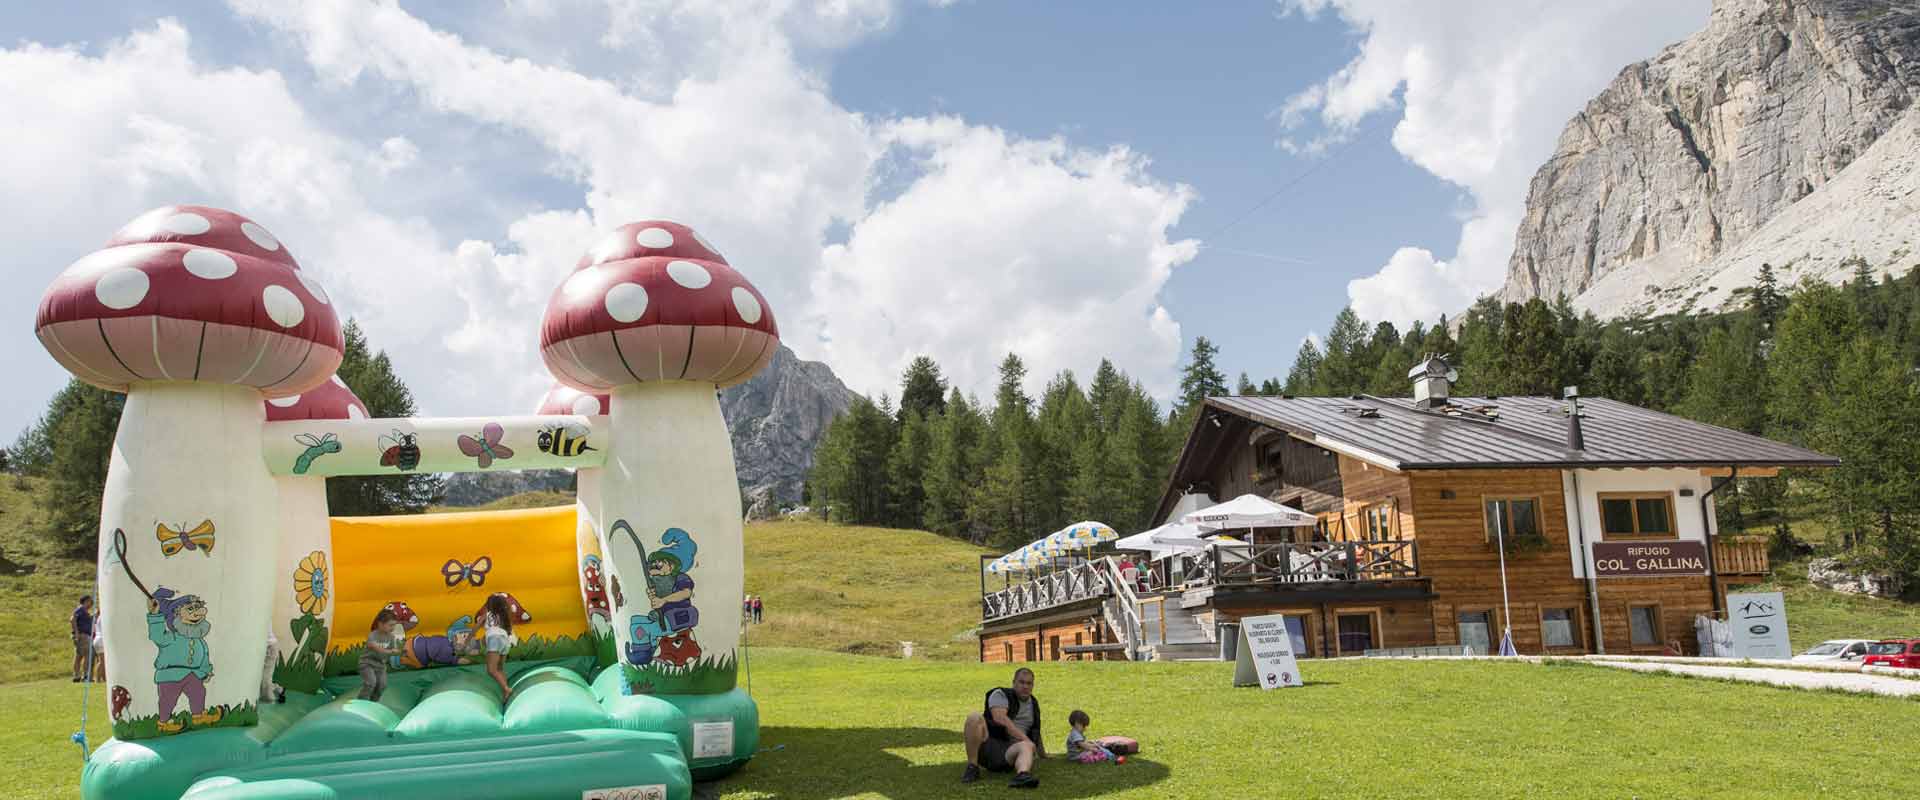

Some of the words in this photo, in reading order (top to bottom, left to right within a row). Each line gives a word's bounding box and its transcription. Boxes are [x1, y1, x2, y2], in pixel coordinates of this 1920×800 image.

[1627, 547, 1671, 556] RIFUGIO
[1596, 559, 1630, 571] COL
[1636, 557, 1704, 570] GALLINA
